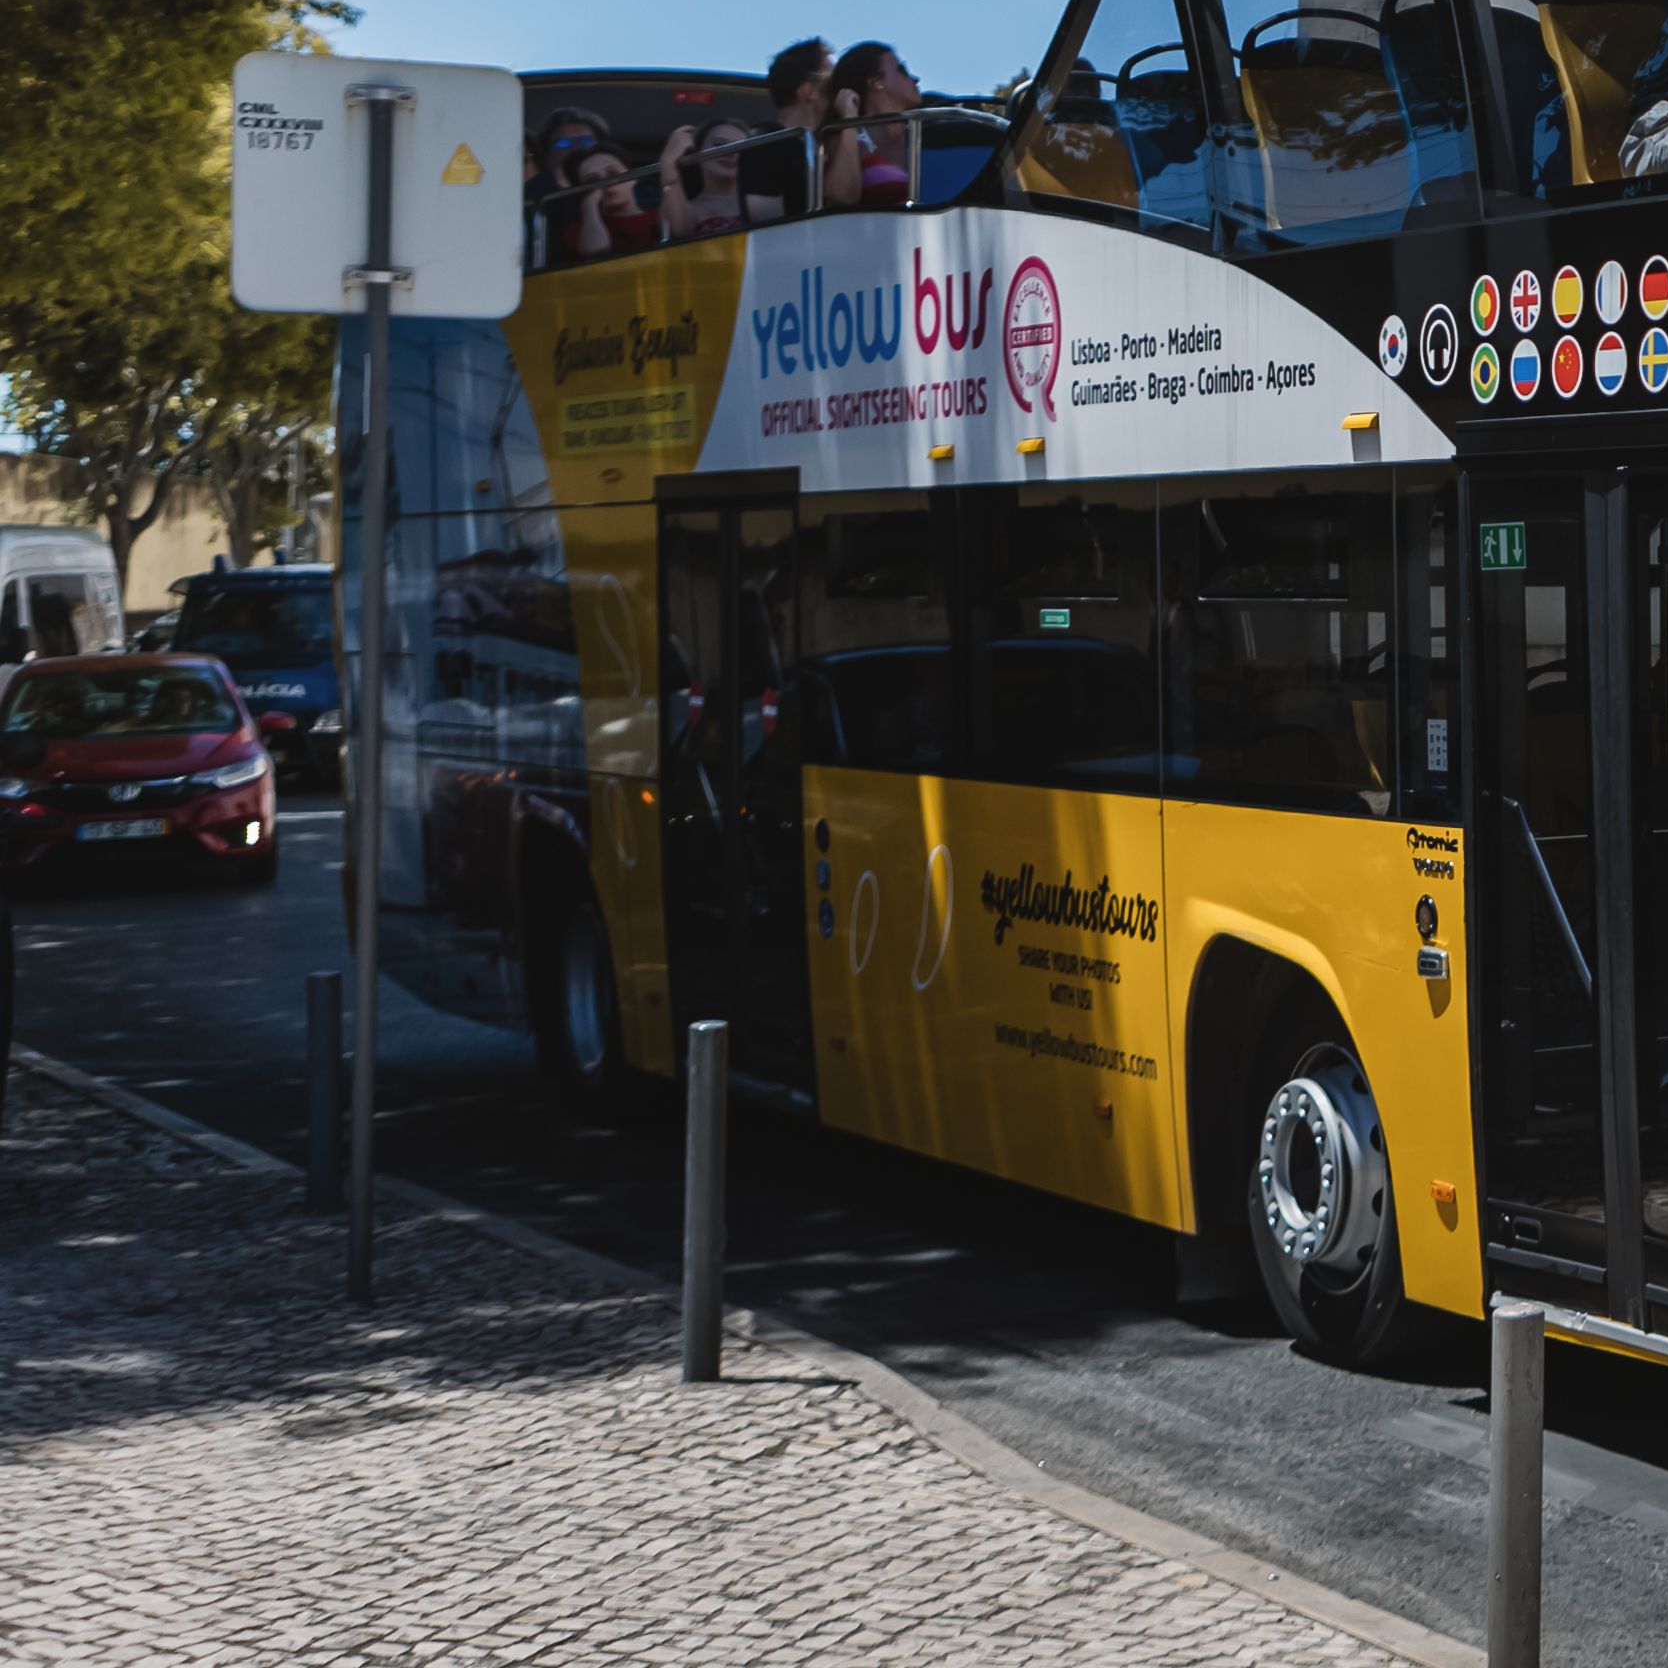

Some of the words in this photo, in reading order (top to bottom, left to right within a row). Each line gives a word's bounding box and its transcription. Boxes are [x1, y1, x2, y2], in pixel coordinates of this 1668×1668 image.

[751, 265, 901, 379] yellow
[914, 247, 993, 355] bus
[1071, 338, 1111, 366] Lisboa
[1121, 333, 1157, 361] Porto
[1168, 323, 1222, 354] Madeira
[762, 397, 824, 437] OFFICIAL
[828, 384, 926, 430] SIGHTSEEING
[931, 377, 987, 418] TOURS
[1071, 375, 1137, 407] Guimarães
[1148, 372, 1186, 405] Braga
[1198, 365, 1254, 396] Coimbra
[1266, 360, 1316, 396] Açores
[981, 863, 1159, 946] #yellowbustours
[1080, 957, 1121, 984] PHOTOS
